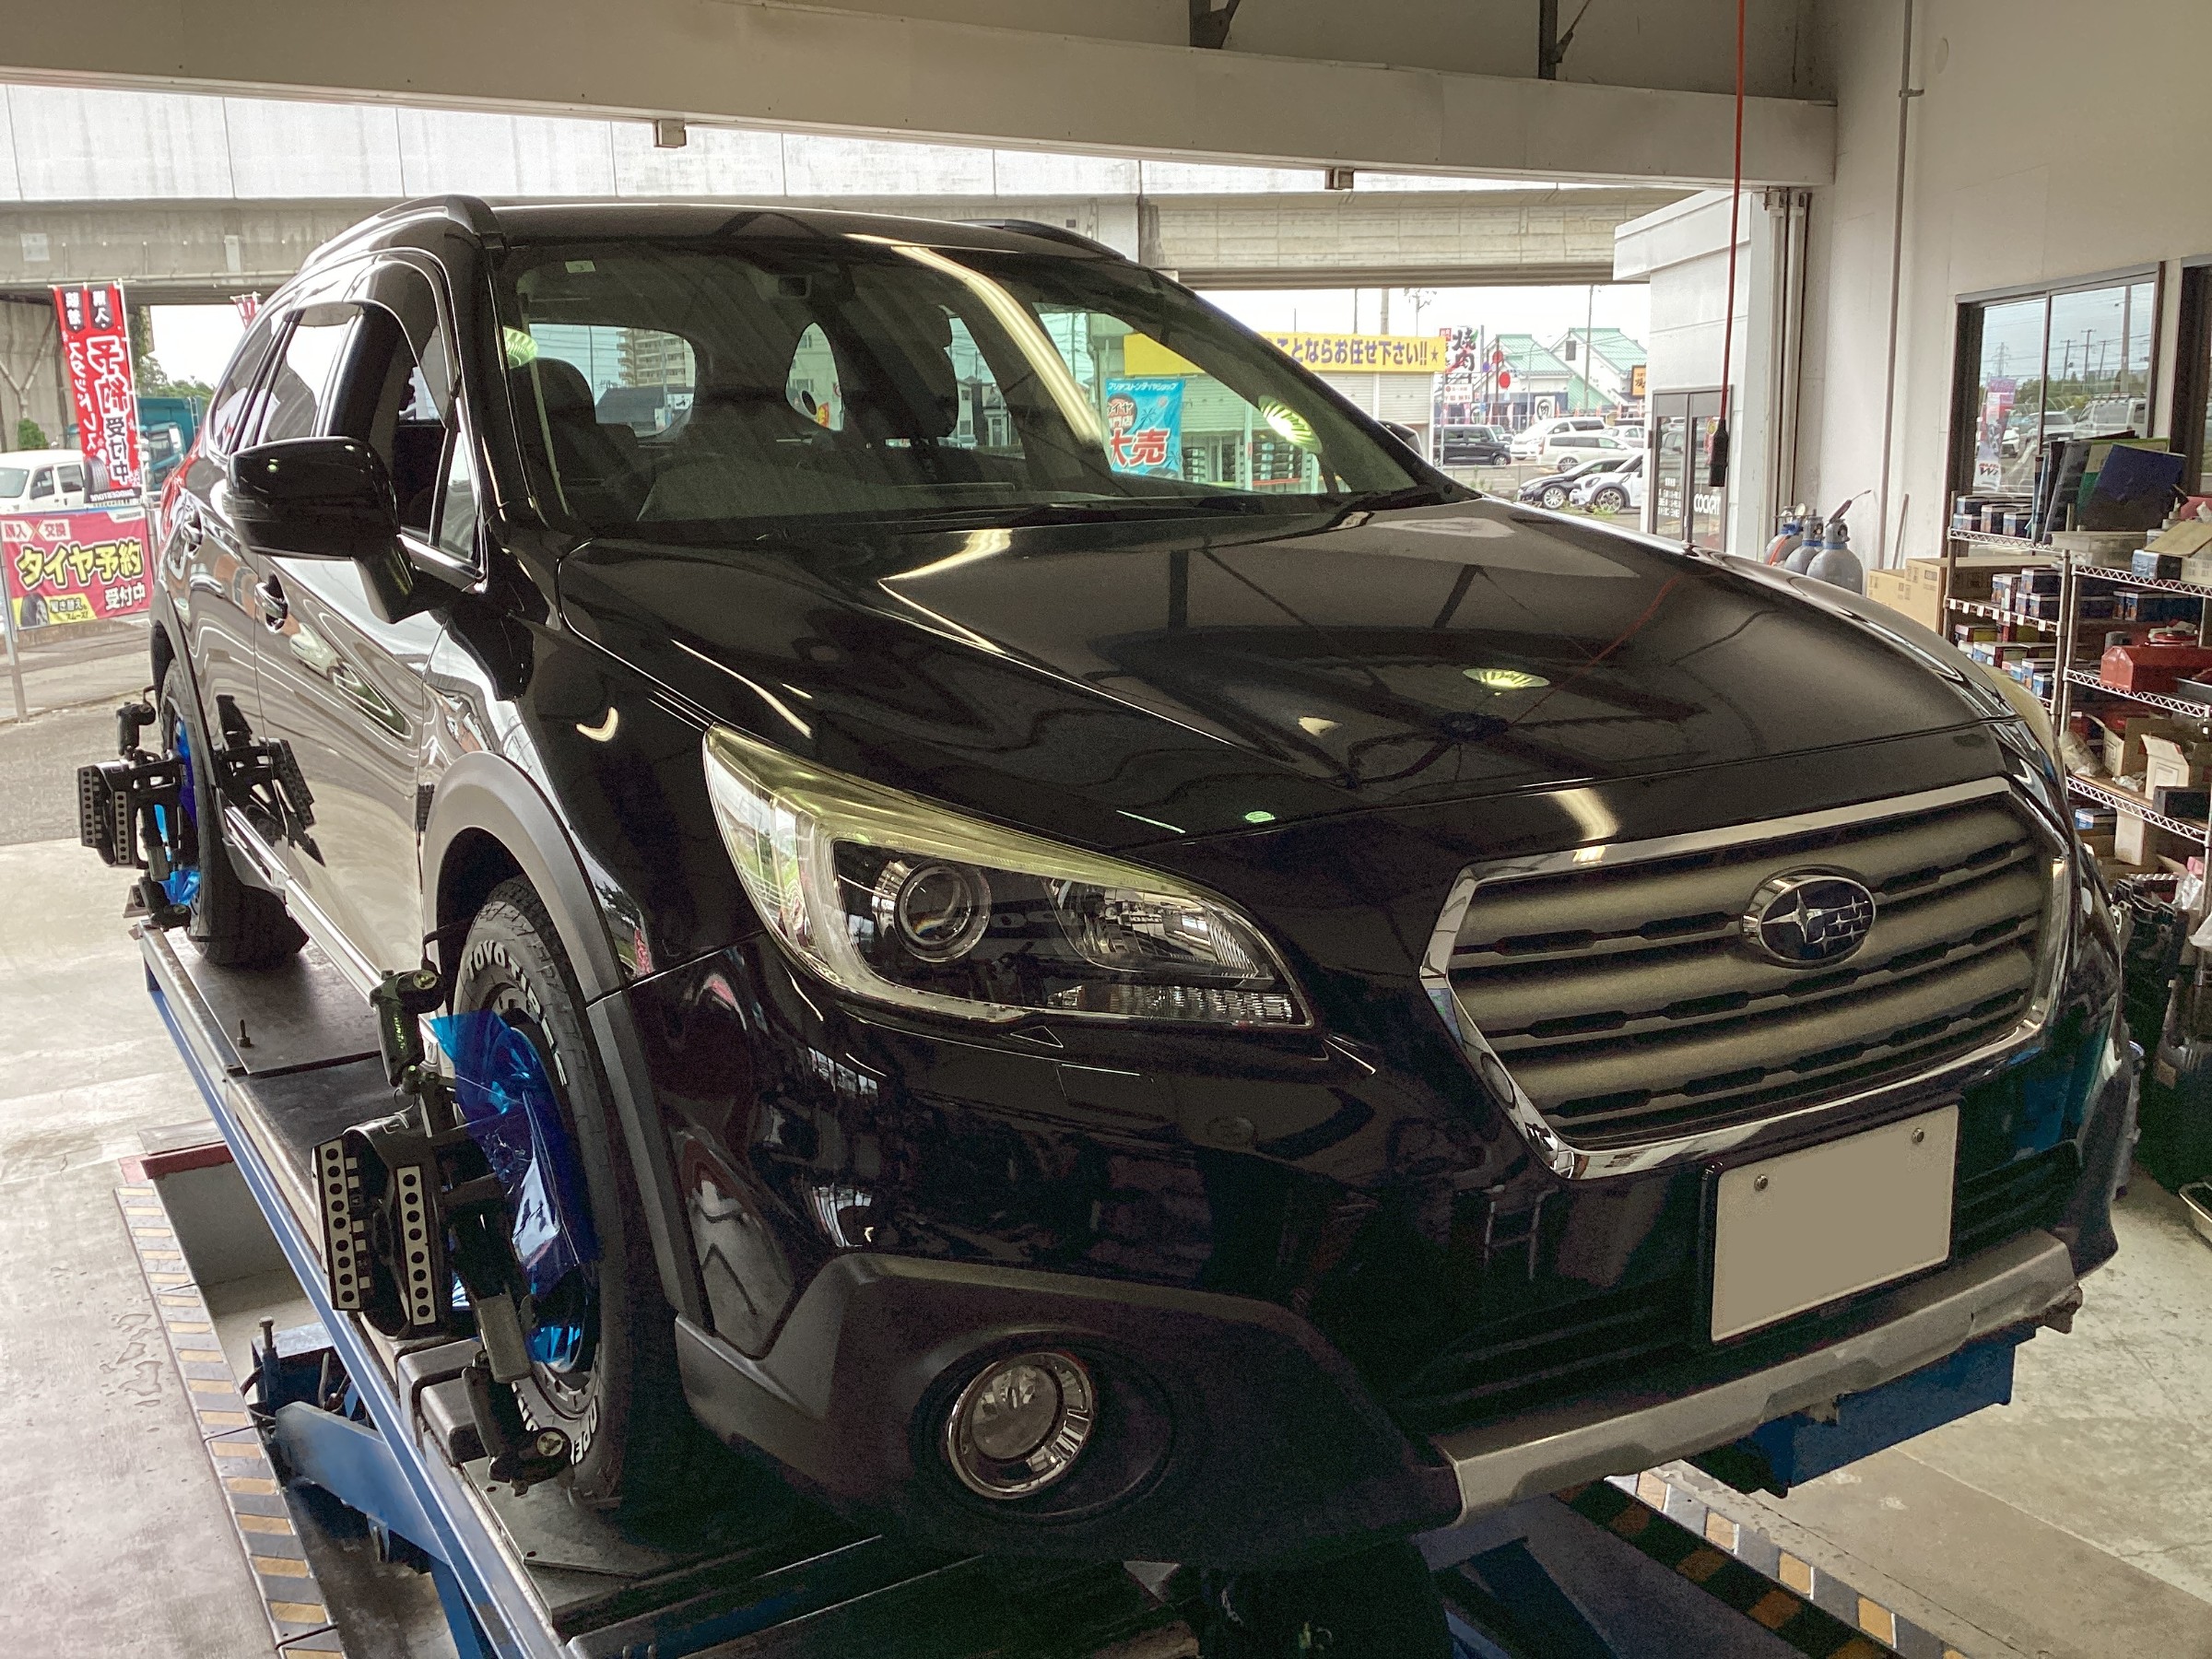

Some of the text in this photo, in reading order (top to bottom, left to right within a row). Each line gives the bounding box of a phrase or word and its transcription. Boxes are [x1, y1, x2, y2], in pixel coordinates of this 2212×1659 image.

[1452, 326, 1477, 372] 焼肉
[1694, 493, 1721, 515] COCKPIT
[16, 537, 145, 590] タイヤ予約
[105, 582, 147, 611] 受付中
[467, 939, 568, 1086] TOYO TIRES
